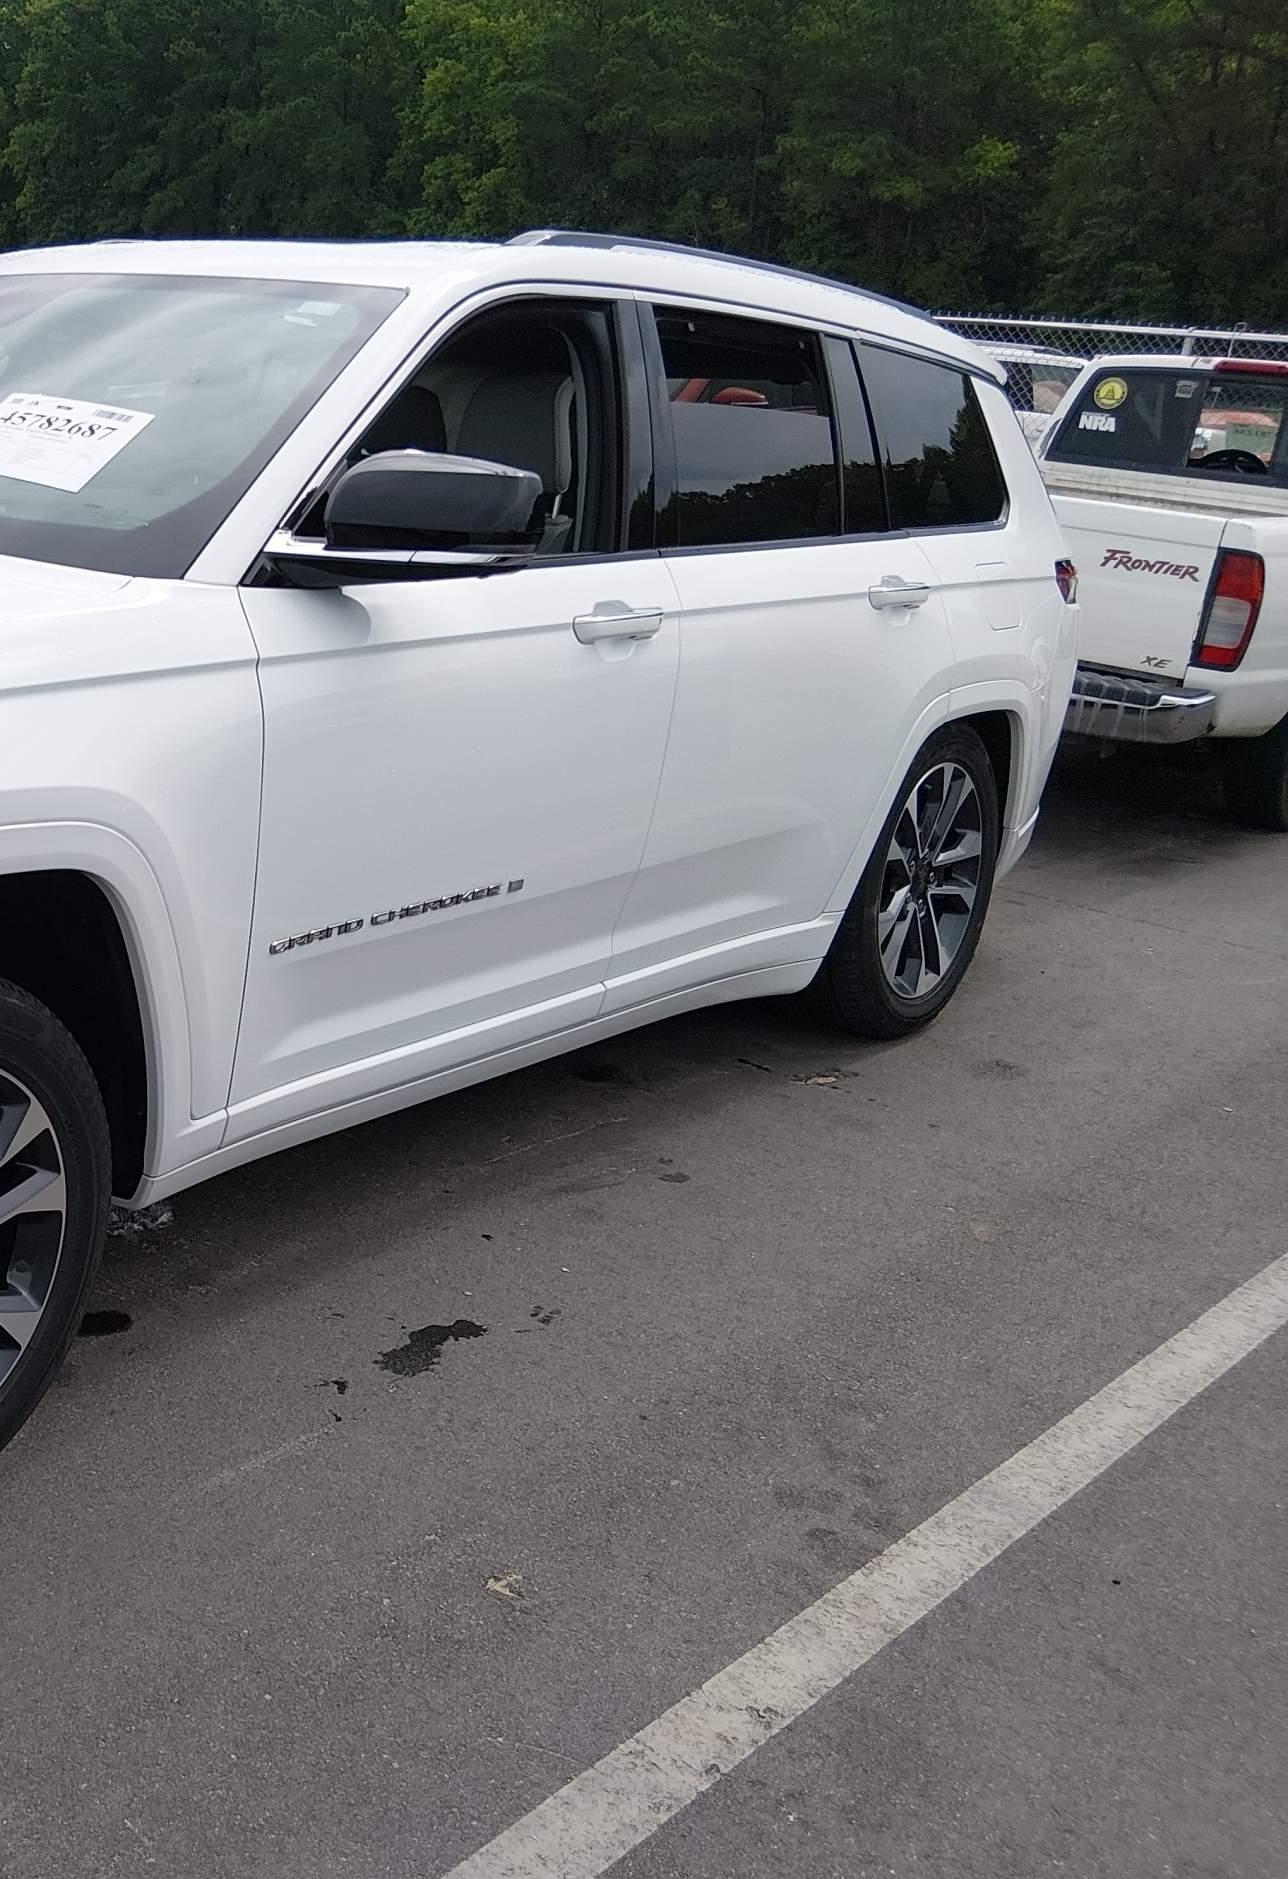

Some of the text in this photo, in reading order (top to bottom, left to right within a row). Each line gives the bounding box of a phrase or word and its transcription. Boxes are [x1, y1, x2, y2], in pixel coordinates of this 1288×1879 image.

[0, 410, 119, 441] 45782687
[1078, 413, 1116, 432] NRA
[1099, 549, 1200, 582] FRONTIER
[1140, 656, 1173, 669] XE
[269, 883, 504, 955] GRAND CHEROKEE
